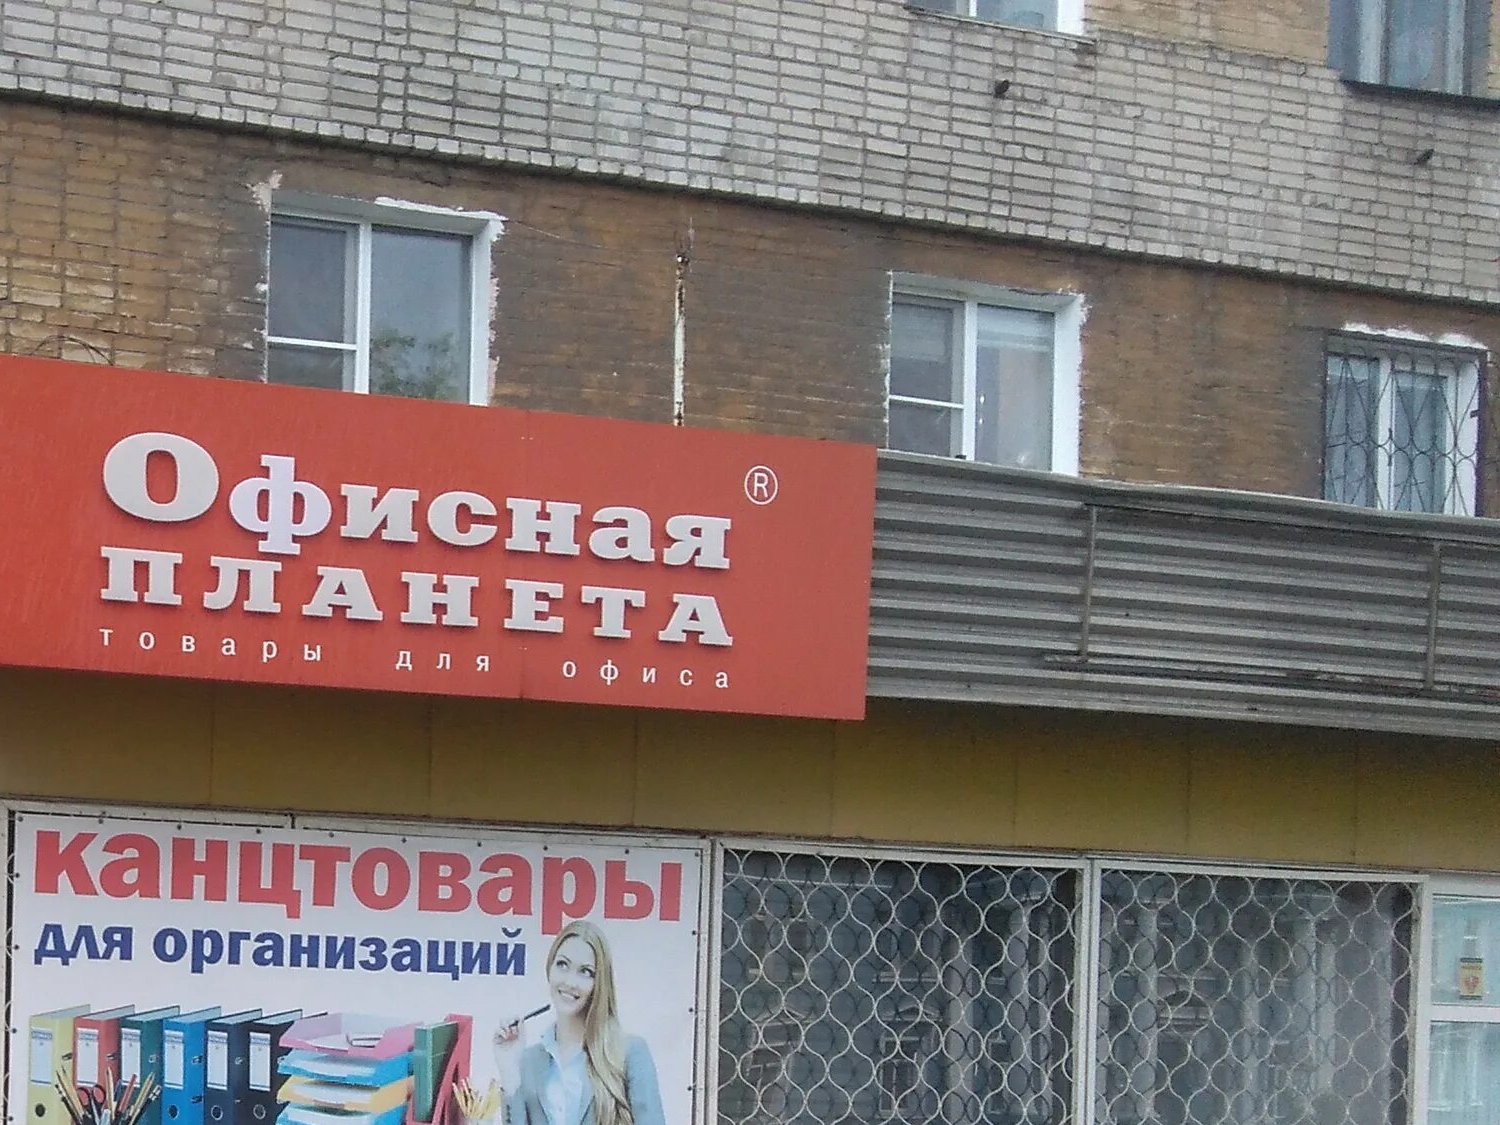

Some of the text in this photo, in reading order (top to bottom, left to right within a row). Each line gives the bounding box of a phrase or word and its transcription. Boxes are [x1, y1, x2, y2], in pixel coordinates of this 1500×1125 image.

[102, 432, 732, 569] Офисная
[100, 546, 733, 646] ПЛАНЕТА
[100, 627, 730, 689] товары для офиса
[35, 829, 682, 935] канцтовары
[35, 923, 526, 980] для организаций
